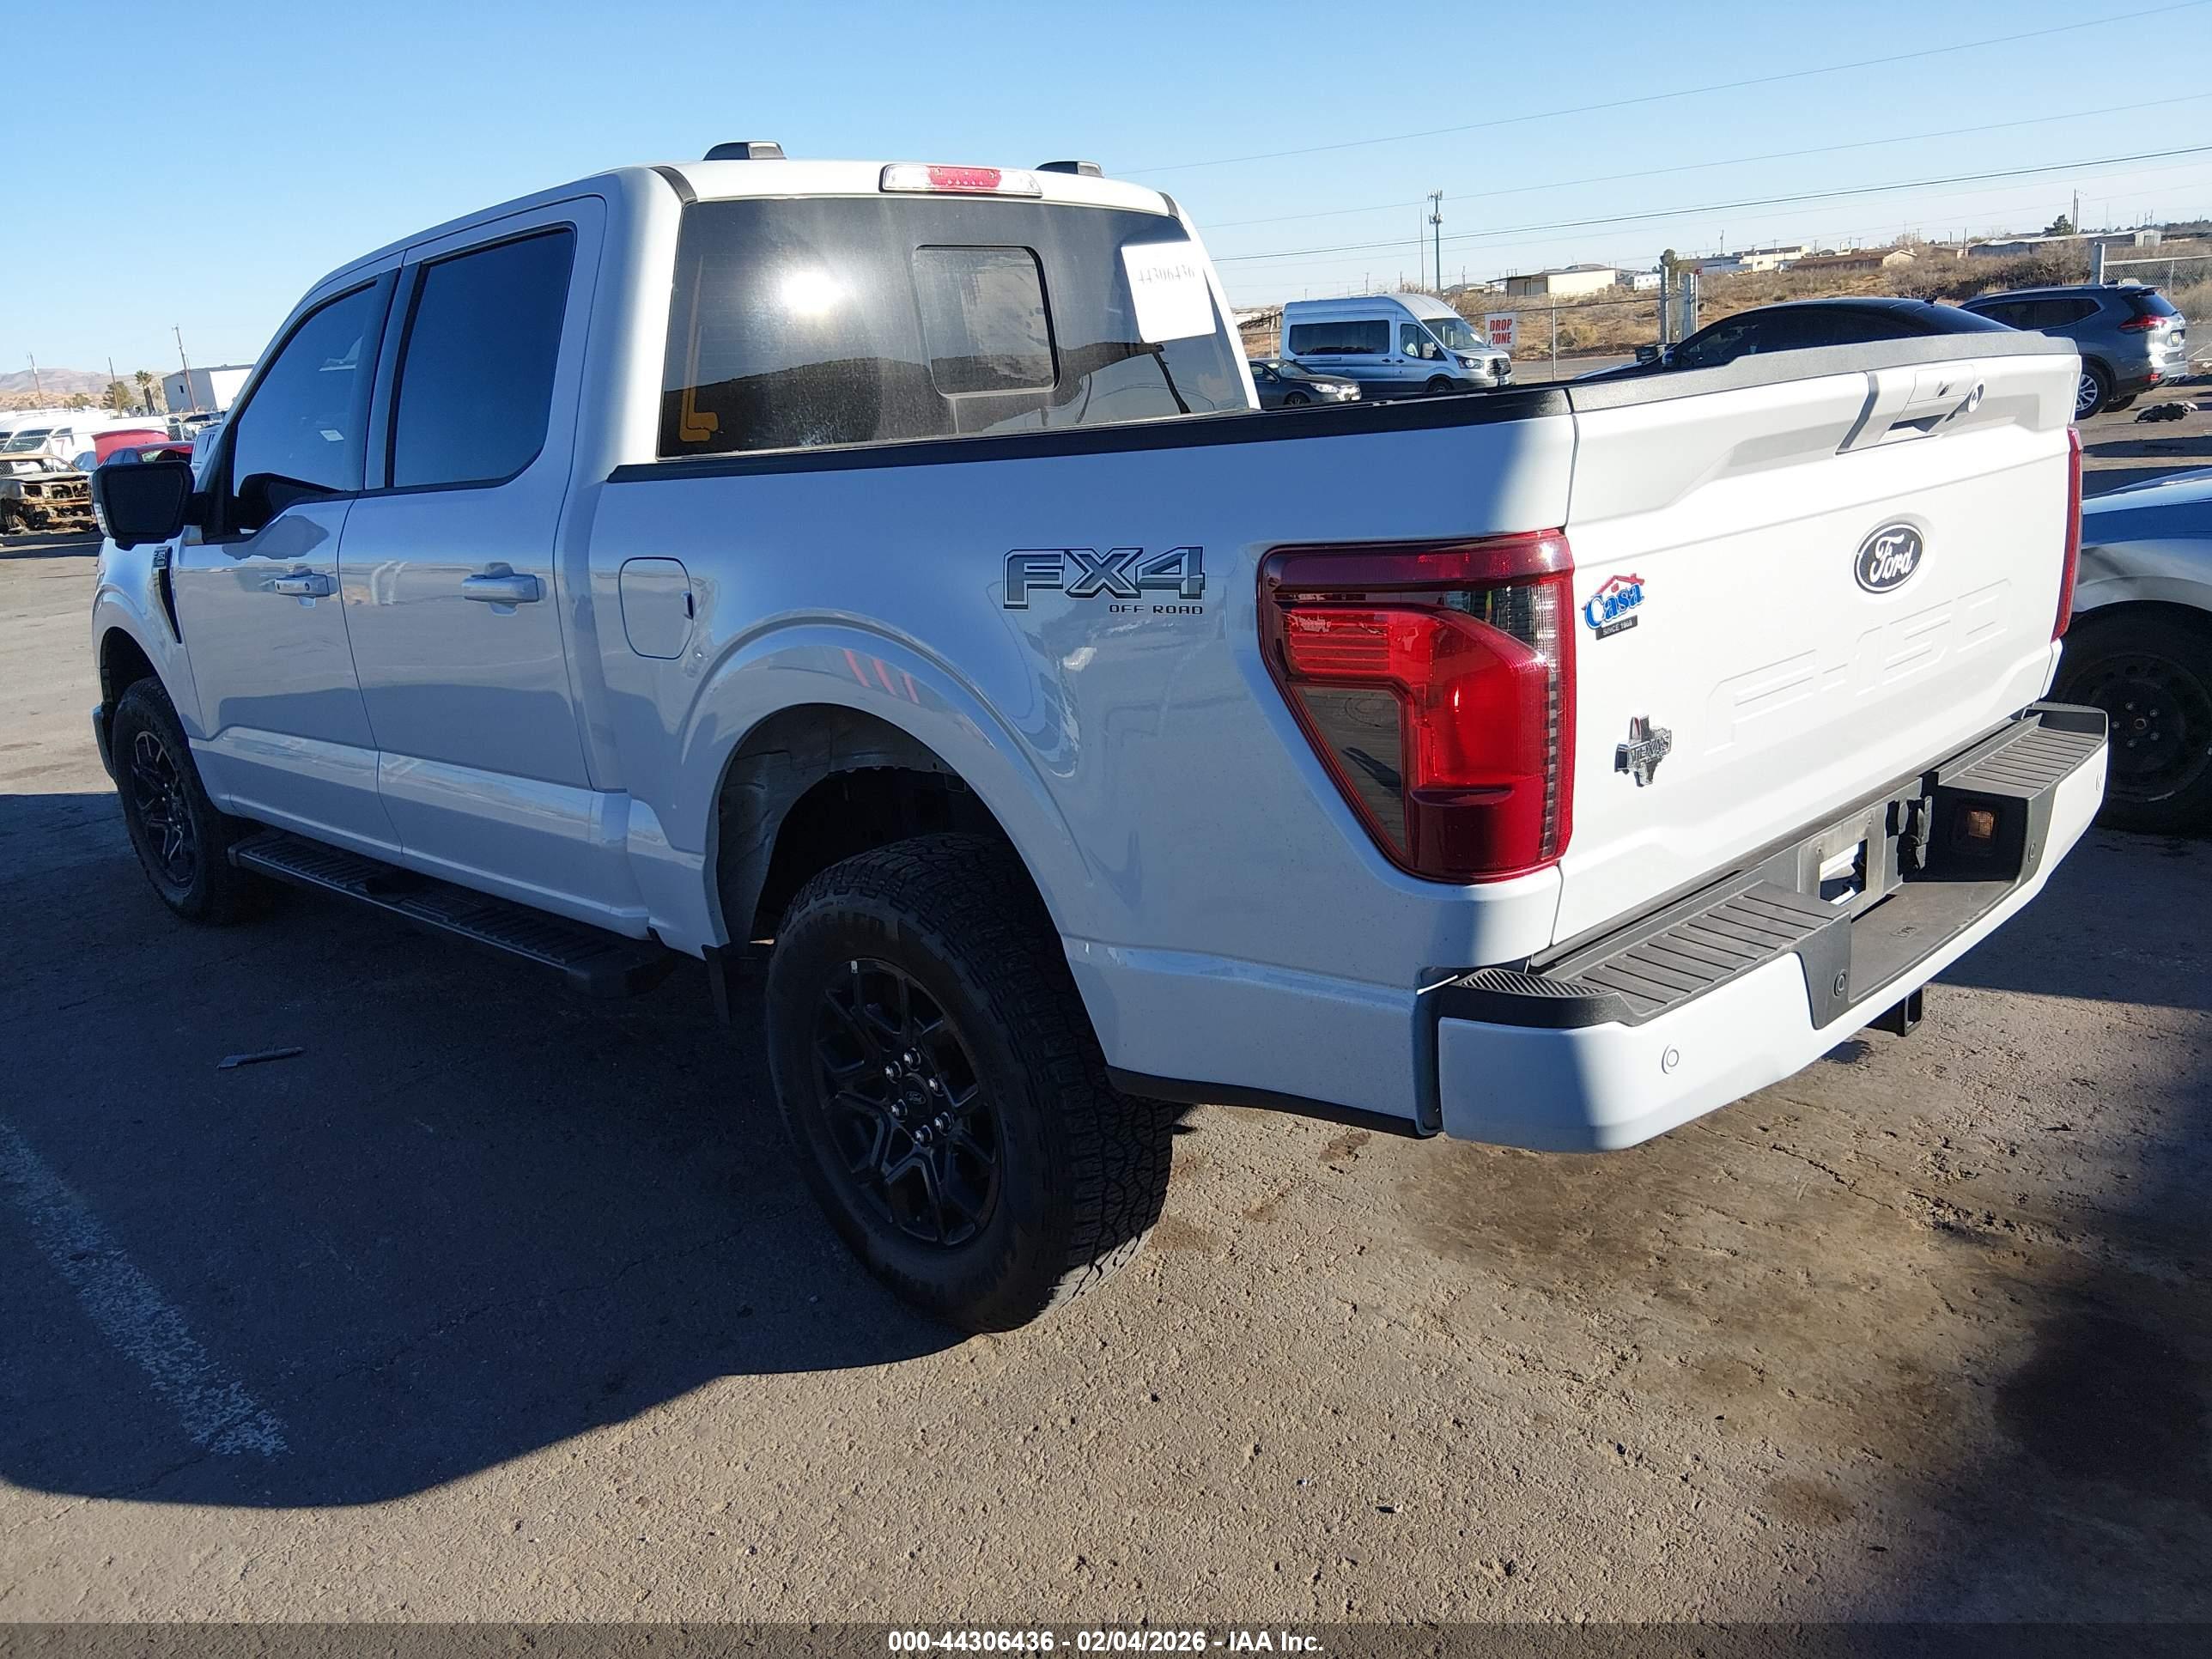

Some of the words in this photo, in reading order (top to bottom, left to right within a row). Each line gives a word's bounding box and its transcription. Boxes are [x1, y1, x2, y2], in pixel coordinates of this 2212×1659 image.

[1489, 318, 1513, 332] DROP
[1869, 533, 1915, 583] Ford
[1003, 546, 1206, 611] FX4
[1109, 605, 1145, 613] OFF
[1152, 605, 1203, 615] ROAD
[1584, 583, 1643, 630] Casa
[1631, 735, 1669, 757] TEXAS
